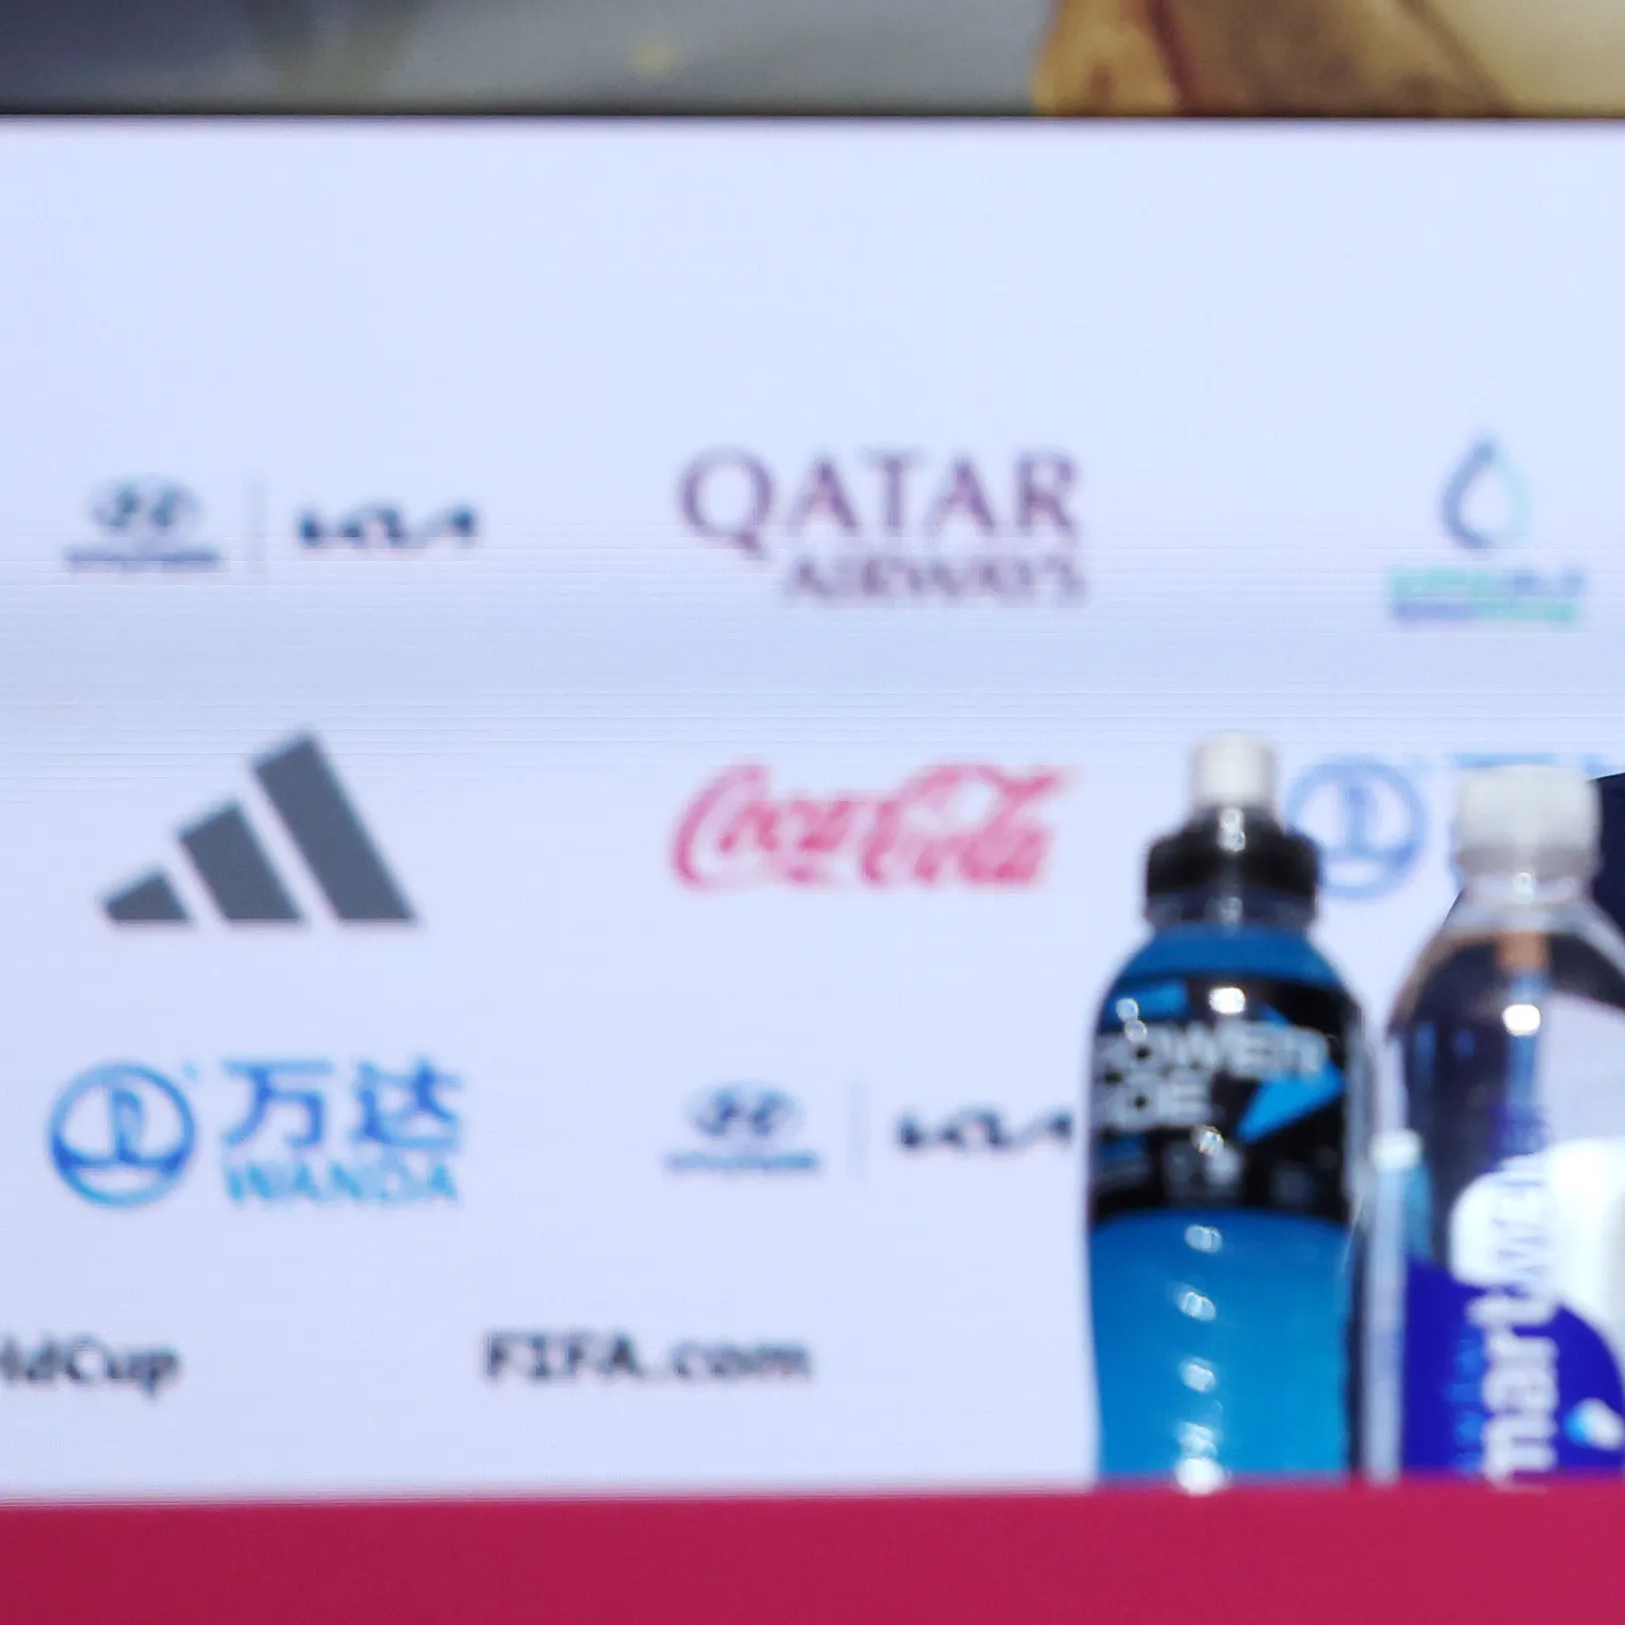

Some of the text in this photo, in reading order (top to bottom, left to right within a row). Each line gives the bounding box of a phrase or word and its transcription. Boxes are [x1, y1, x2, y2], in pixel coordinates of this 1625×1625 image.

[680, 445, 1080, 560] QATAR
[220, 1053, 462, 1149] 万达
[484, 1328, 812, 1381] FIFA.com
